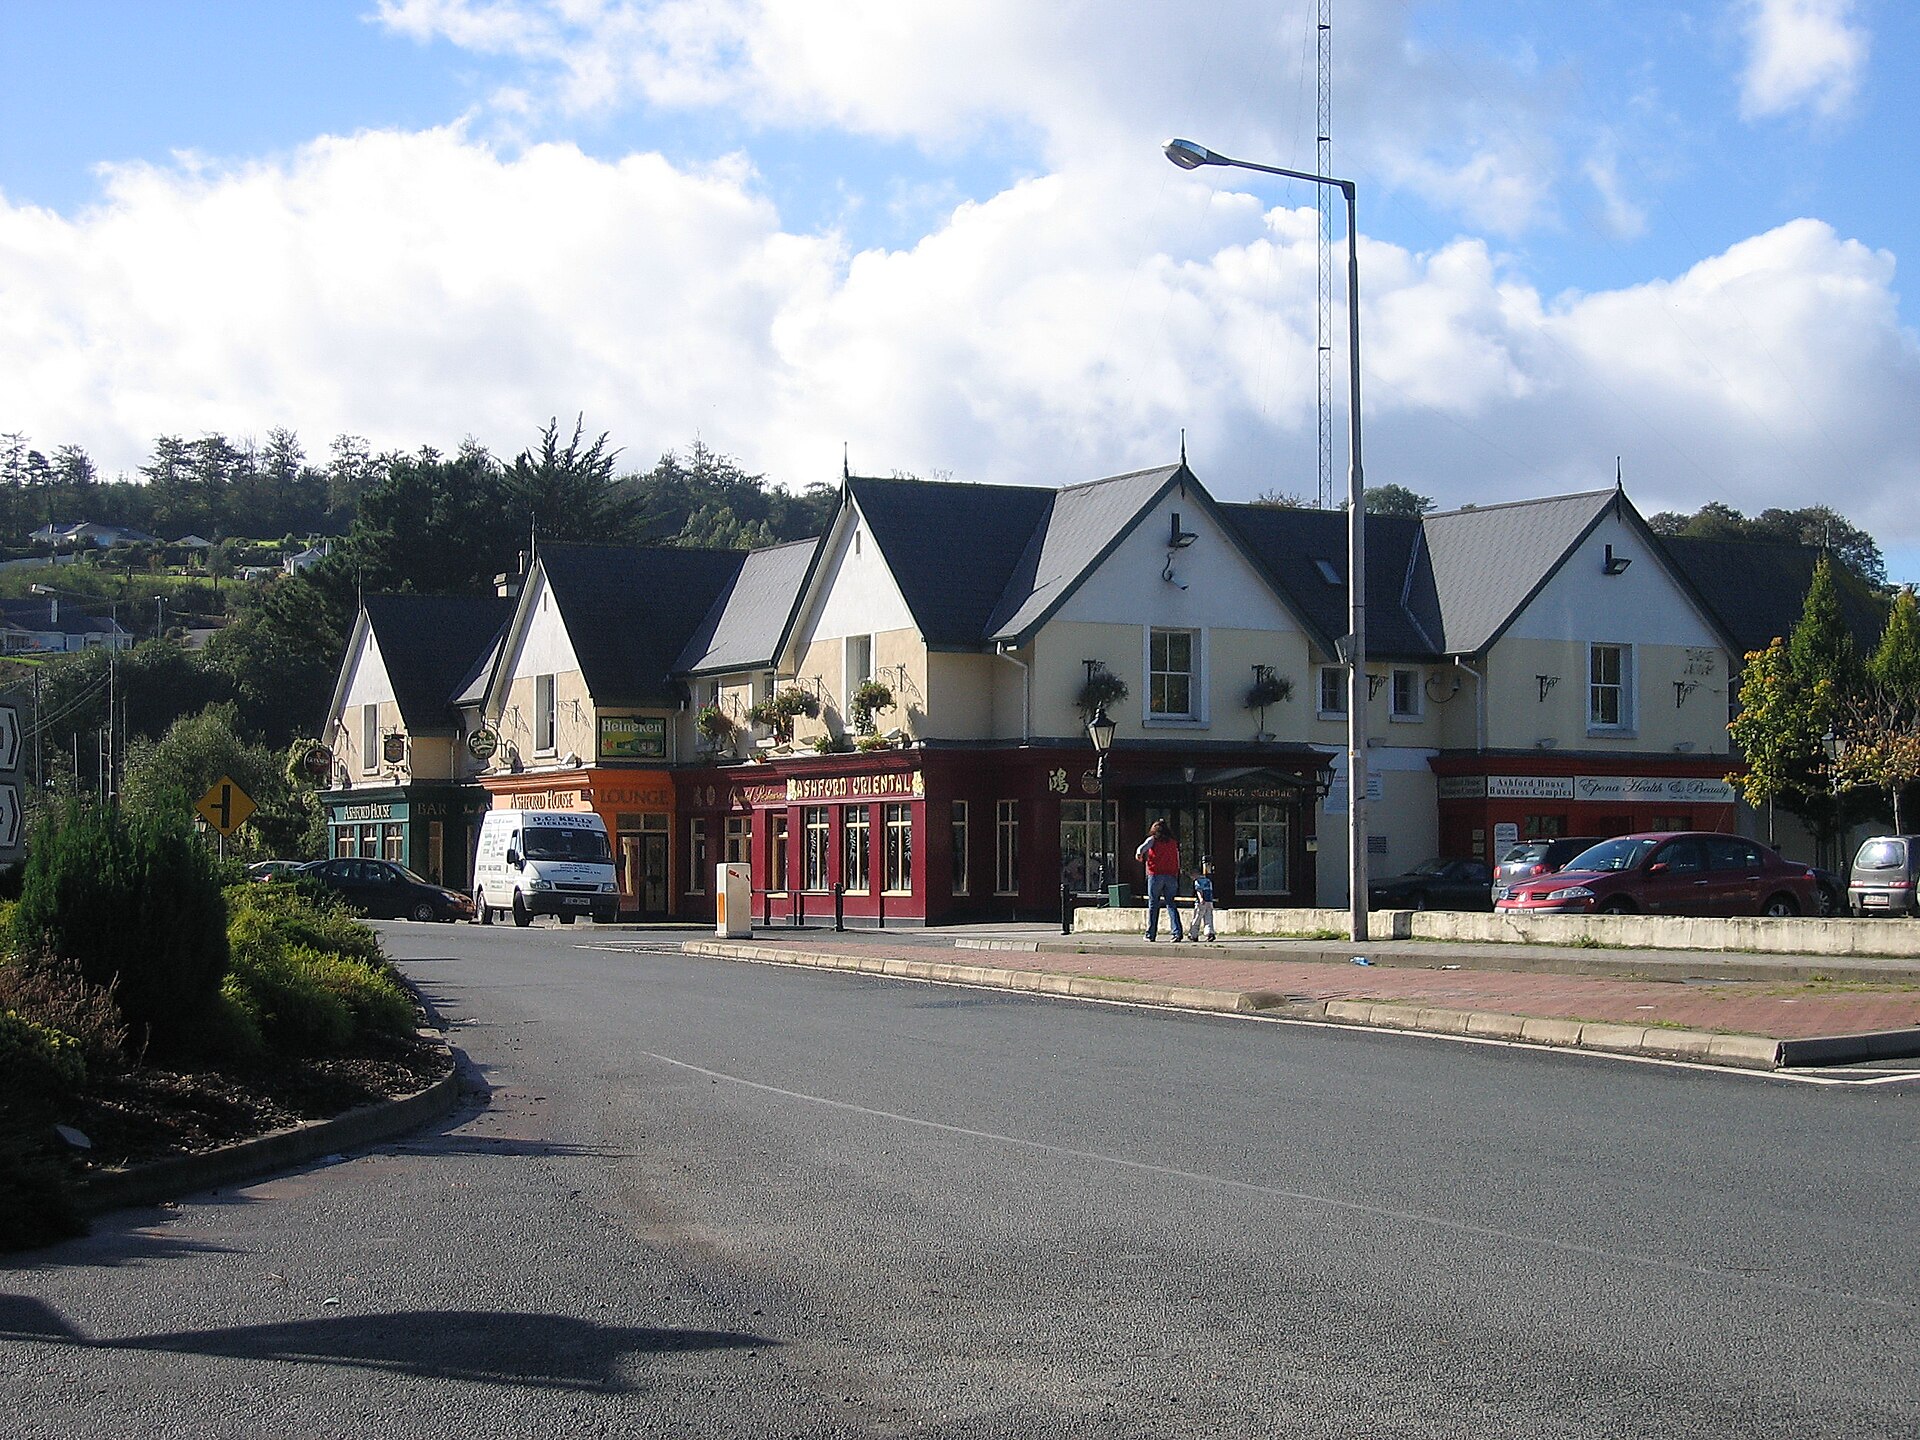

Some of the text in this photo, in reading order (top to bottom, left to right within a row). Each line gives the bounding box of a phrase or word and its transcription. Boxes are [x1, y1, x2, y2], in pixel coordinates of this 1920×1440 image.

[602, 718, 662, 733] Heineken
[797, 777, 847, 798] ASHFORD
[852, 774, 911, 796] ORIENTAL
[1498, 778, 1564, 788] Ashford House
[1578, 778, 1620, 796] Epona
[1622, 777, 1663, 794] Health
[1687, 780, 1731, 797] Beauty
[600, 789, 669, 805] LOUNGE
[1489, 787, 1529, 796] Business
[1532, 788, 1572, 797] Complex
[417, 802, 448, 815] BAR
[559, 816, 593, 825] KELLY
